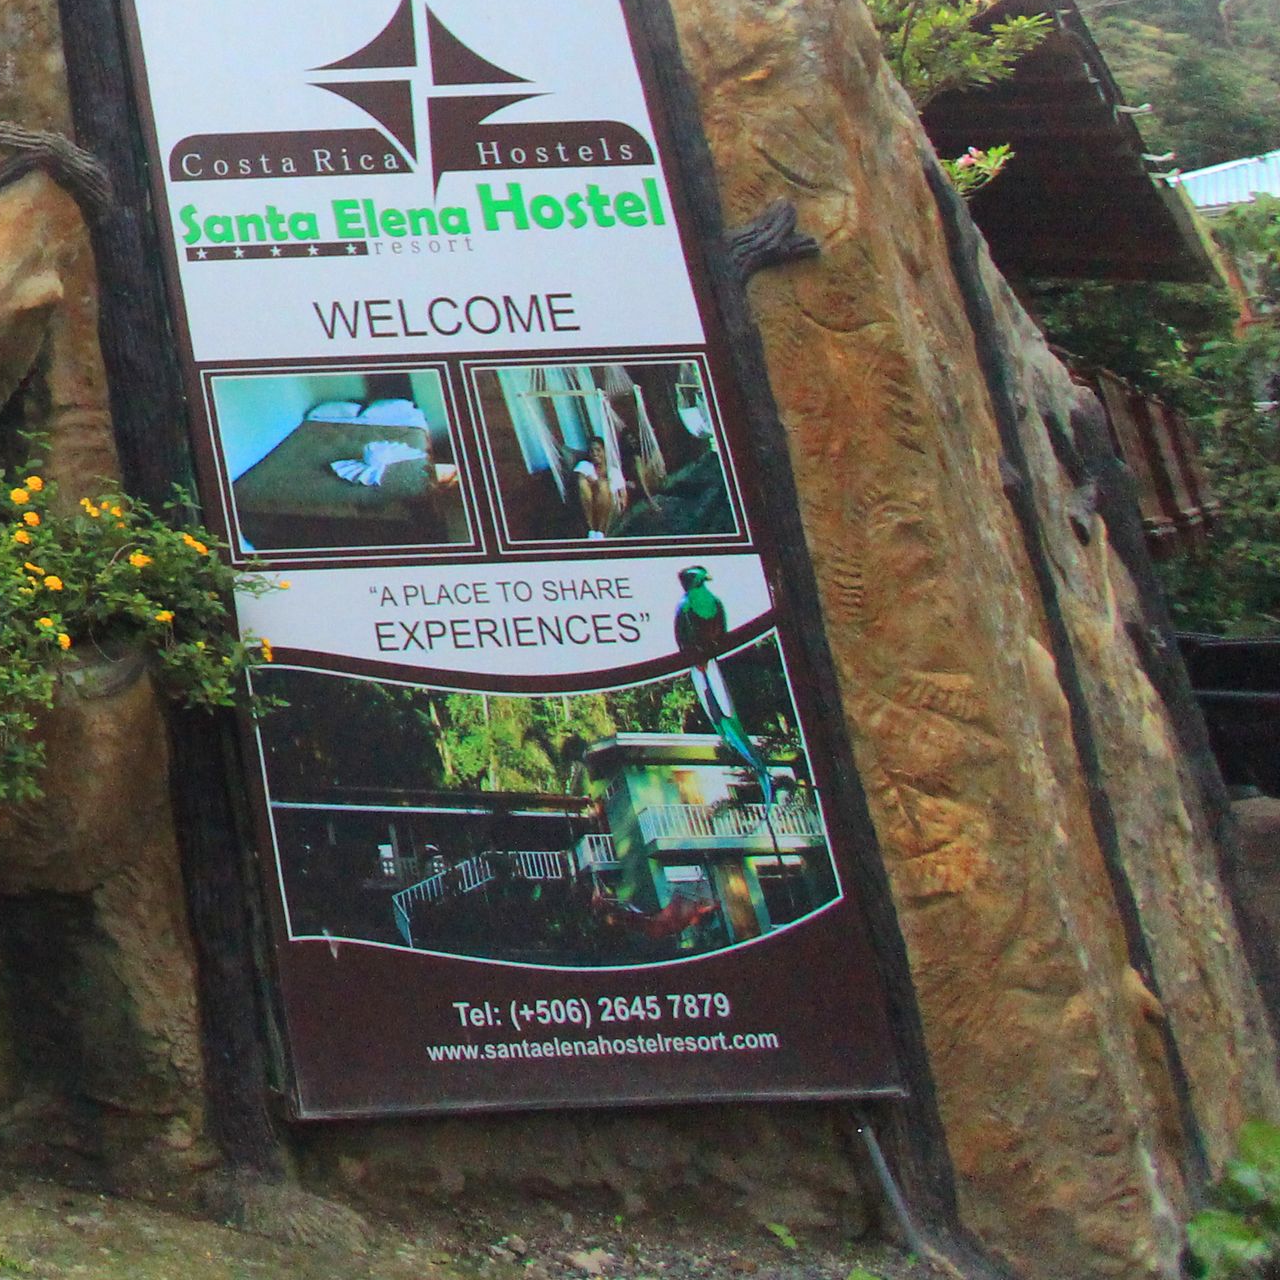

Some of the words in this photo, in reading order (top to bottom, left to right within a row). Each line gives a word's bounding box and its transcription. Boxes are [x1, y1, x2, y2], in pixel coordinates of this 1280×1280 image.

[182, 149, 297, 177] Costa
[313, 148, 400, 172] Rica
[476, 137, 634, 166] Hostels
[179, 204, 318, 245] Santa
[330, 198, 471, 240] Elena
[475, 177, 667, 231] Hostel
[373, 234, 475, 256] resort
[313, 292, 581, 340] WELCOME
[403, 582, 490, 606] PLACE
[495, 580, 536, 604] TO
[541, 577, 634, 602] SHARE
[452, 1000, 503, 1027] Tel:
[510, 997, 592, 1029] (+506)
[597, 996, 661, 1022] 2645
[666, 993, 731, 1019] 7879
[426, 1031, 779, 1062] www.santaelenahostelresort.com
